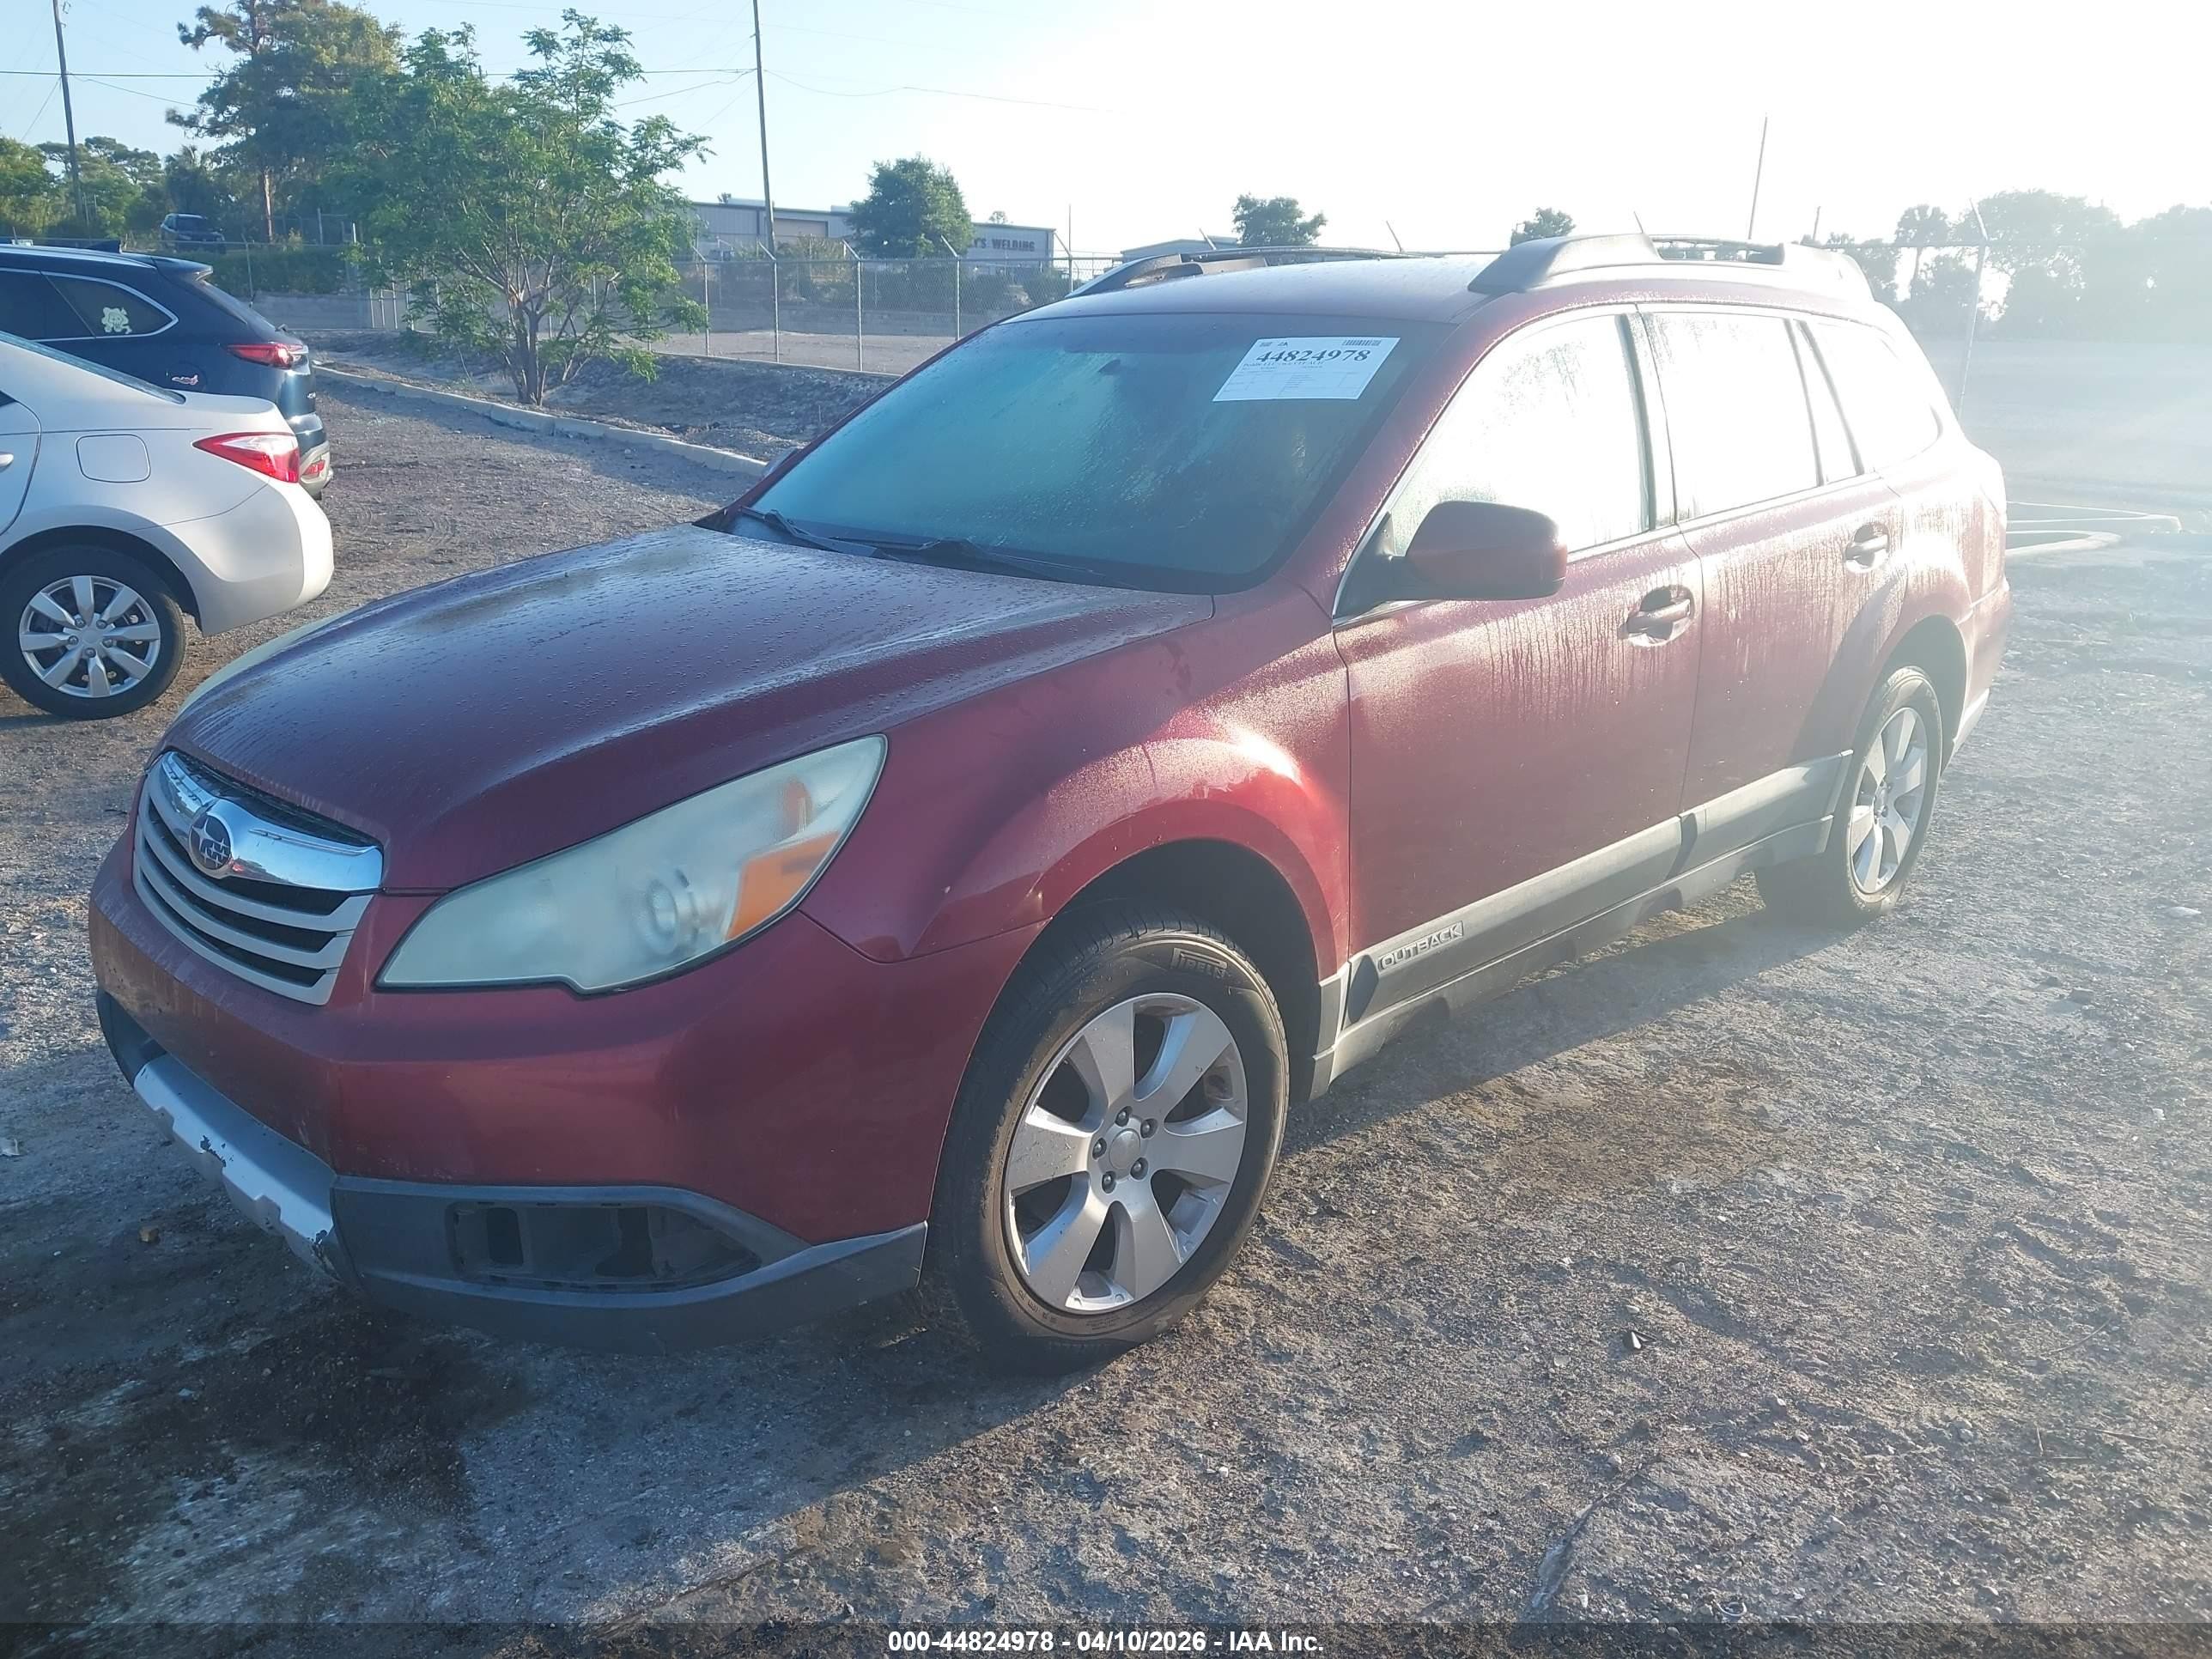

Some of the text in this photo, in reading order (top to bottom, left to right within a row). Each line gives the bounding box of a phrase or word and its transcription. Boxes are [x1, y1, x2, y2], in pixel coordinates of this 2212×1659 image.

[991, 238, 1036, 252] WELDING
[1256, 349, 1370, 362] 44824978
[1381, 922, 1462, 970] OUTBACK
